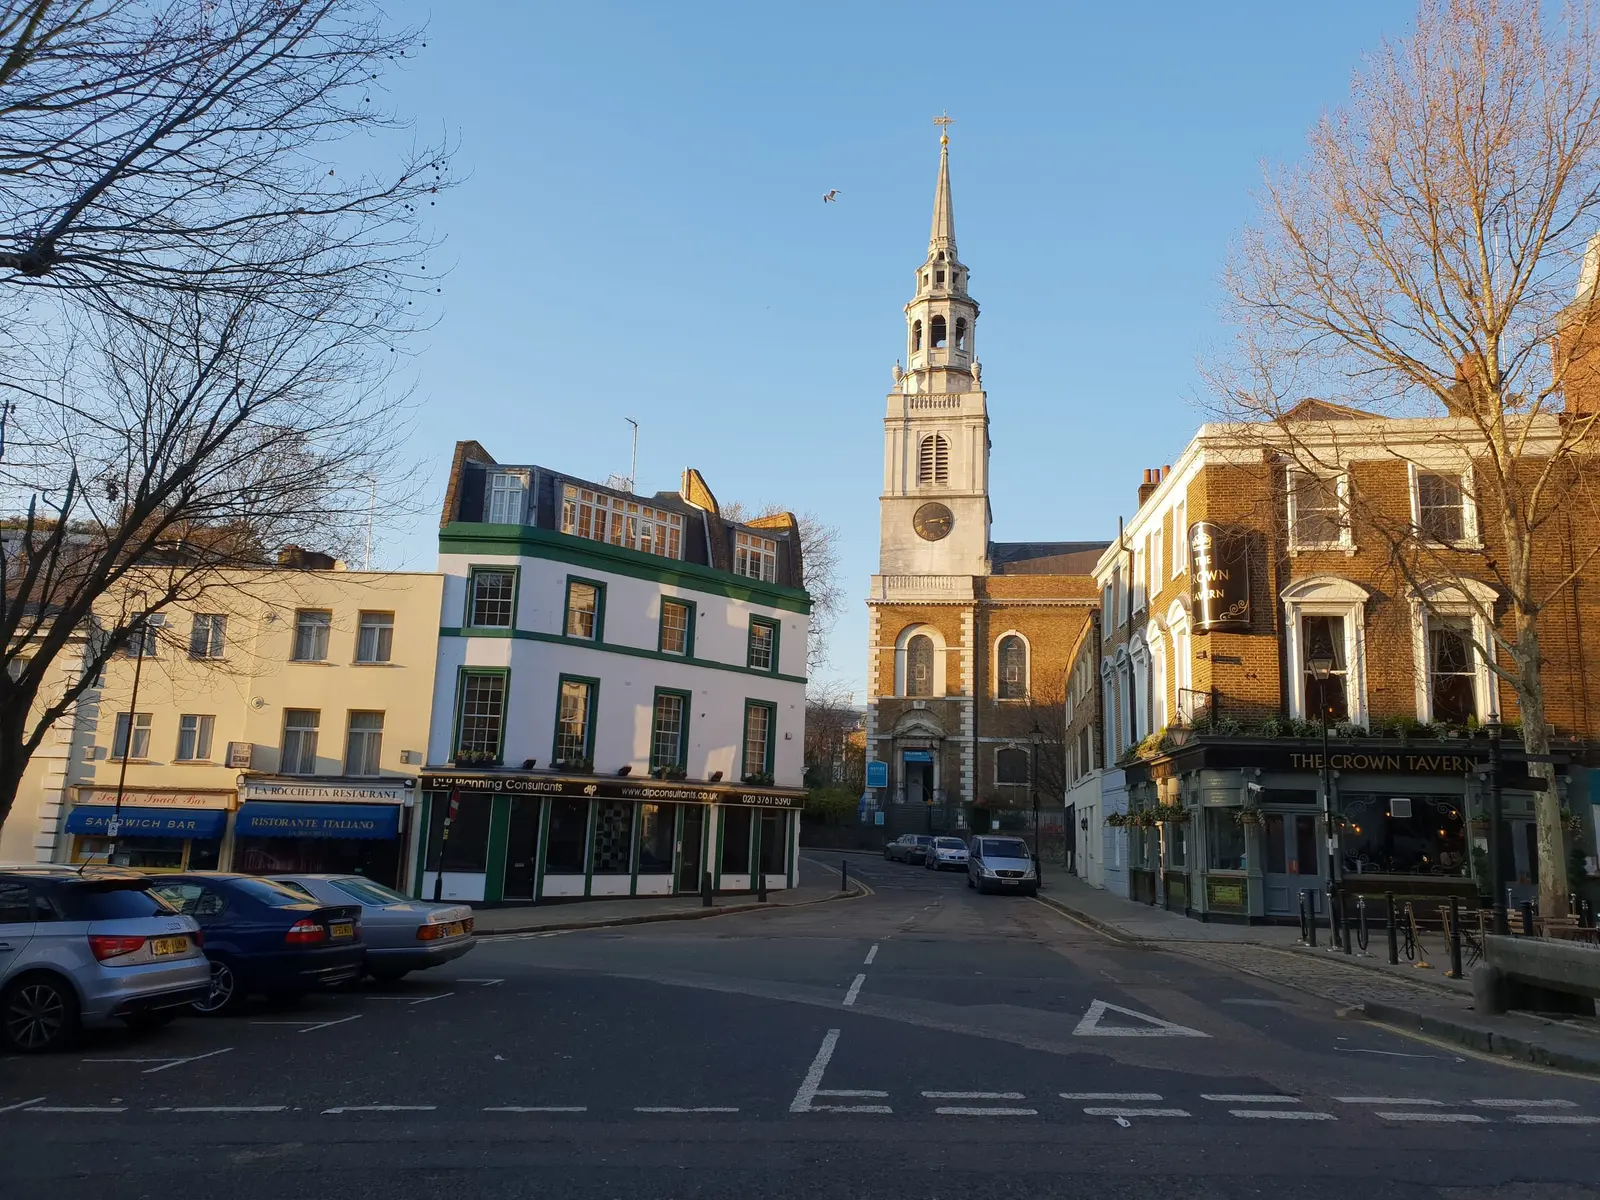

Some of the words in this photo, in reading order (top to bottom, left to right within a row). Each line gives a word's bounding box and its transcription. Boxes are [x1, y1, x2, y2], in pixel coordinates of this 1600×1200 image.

[1191, 569, 1229, 585] ROWN
[1289, 753, 1325, 769] THE
[1330, 754, 1400, 770] CROWN
[1405, 755, 1479, 771] TAVERN
[505, 779, 563, 792] Consultants
[144, 792, 178, 804] Snack
[183, 793, 208, 805] Bar
[254, 786, 267, 795] LA
[270, 786, 329, 797] ROCCHETTA
[332, 788, 398, 799] RESTAURANT
[621, 787, 719, 801] www.dlpconsultants.co.uk
[742, 794, 756, 803] 020
[757, 795, 773, 804] 3761
[167, 820, 197, 829] BAR
[251, 817, 318, 828] RISTORANTE
[322, 819, 374, 829] ITALIANO
